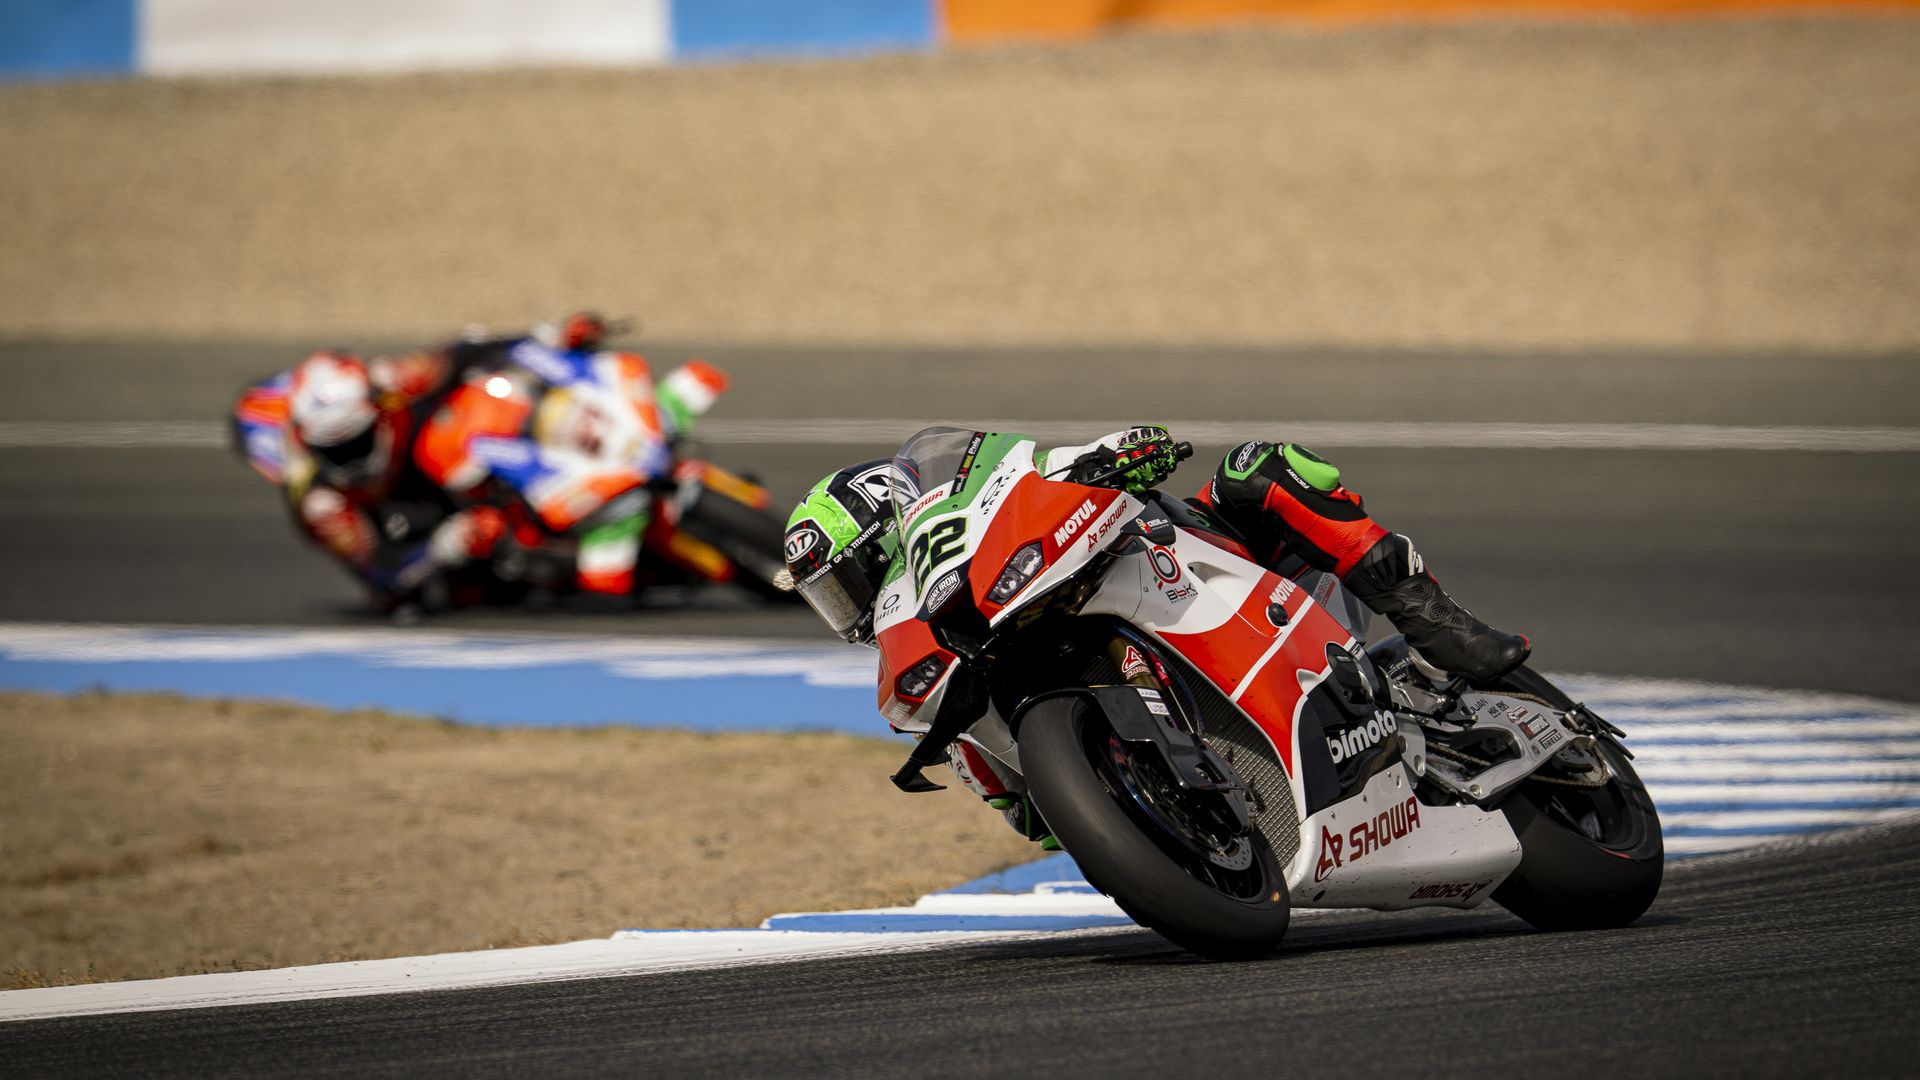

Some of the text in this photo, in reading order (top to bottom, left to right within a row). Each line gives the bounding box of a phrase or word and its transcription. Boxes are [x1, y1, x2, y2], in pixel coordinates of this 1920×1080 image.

[1286, 468, 1310, 489] FACTORY
[1054, 499, 1097, 547] MOTUL
[1100, 499, 1128, 539] SHOWA
[805, 562, 832, 585] TITANTECH
[833, 554, 843, 564] GP
[850, 521, 881, 549] TITANTECH
[910, 516, 968, 602] 22
[939, 573, 958, 593] IRON
[876, 605, 901, 623] OAKLEY
[1326, 710, 1397, 764] bimota
[1539, 728, 1563, 750] PIRELLI
[1350, 796, 1421, 862] SHOWA
